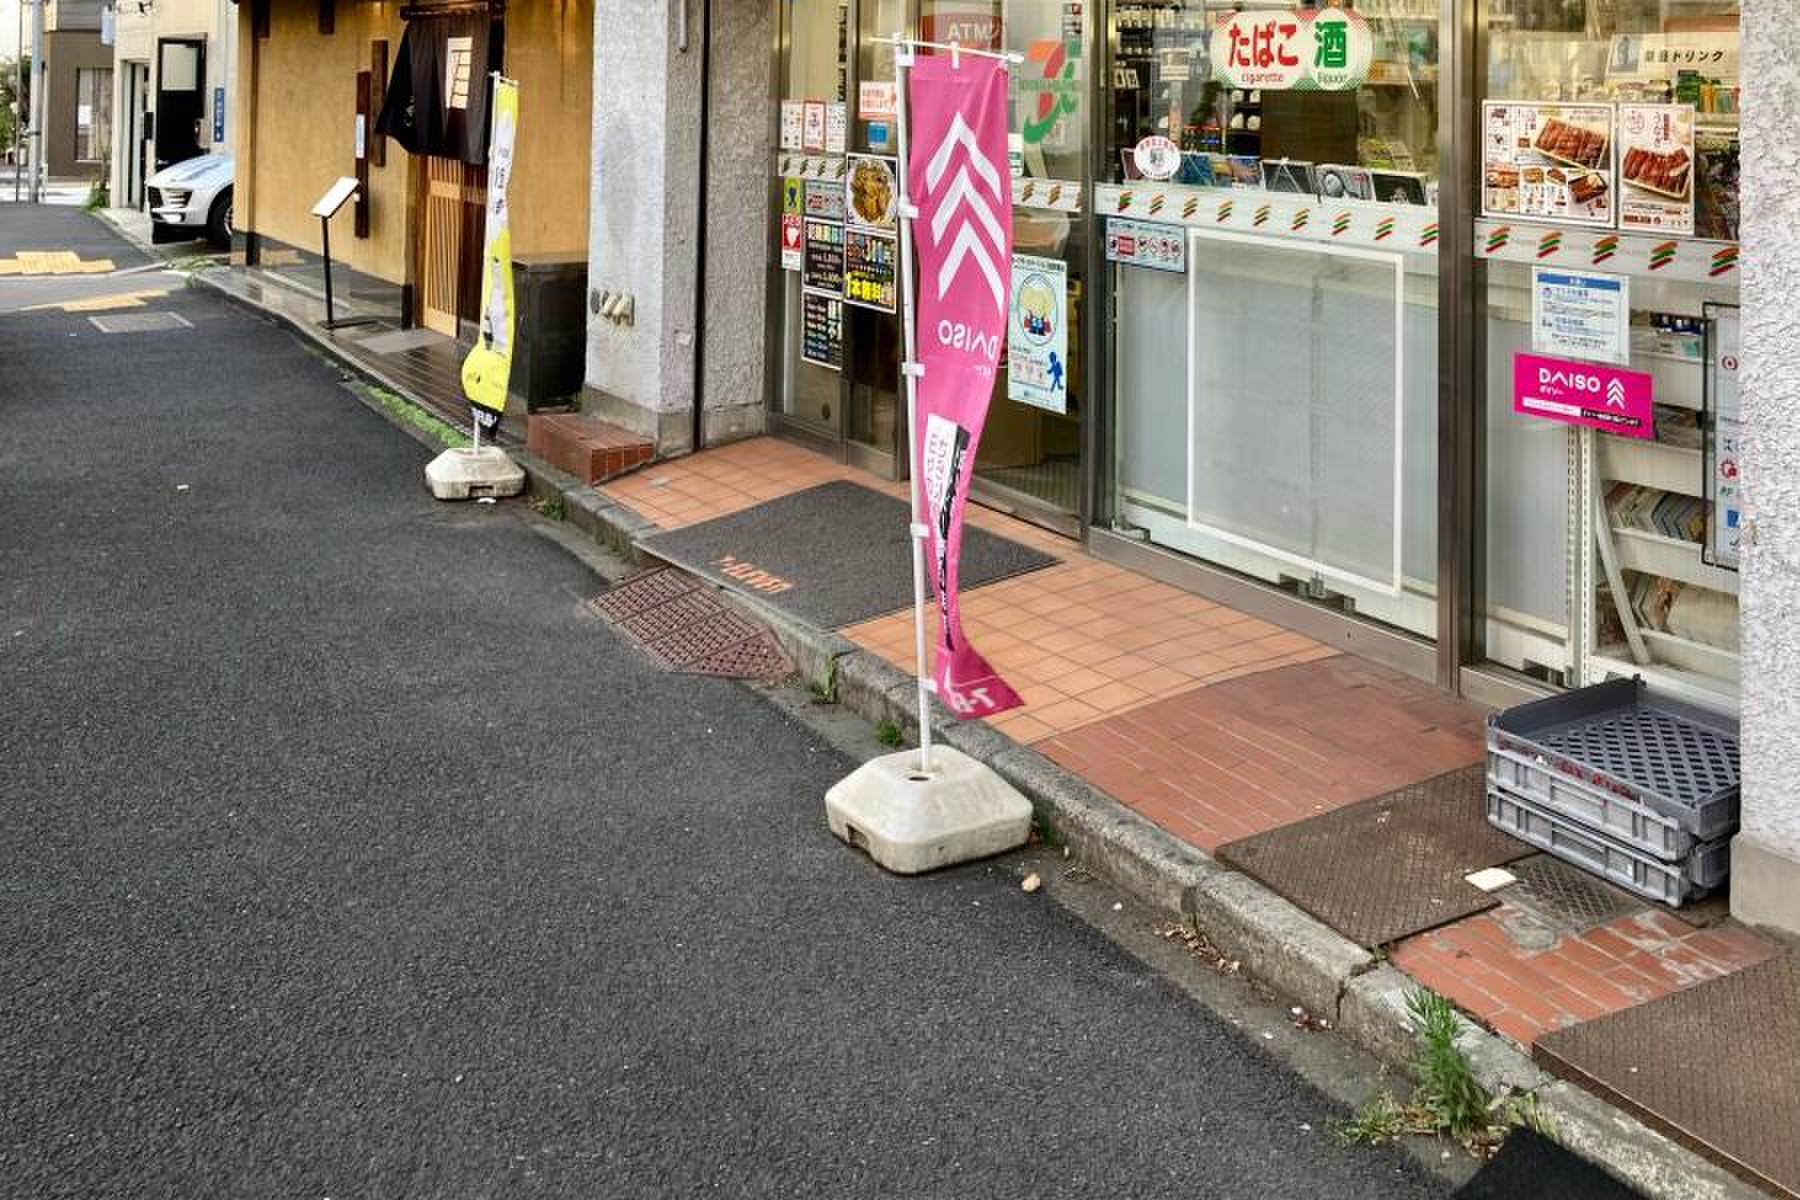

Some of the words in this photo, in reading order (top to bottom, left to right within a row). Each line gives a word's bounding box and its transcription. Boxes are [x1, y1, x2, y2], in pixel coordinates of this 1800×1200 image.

[1229, 20, 1299, 68] たばこ
[1314, 20, 1348, 69] 酒
[1539, 367, 1601, 392] DAISO
